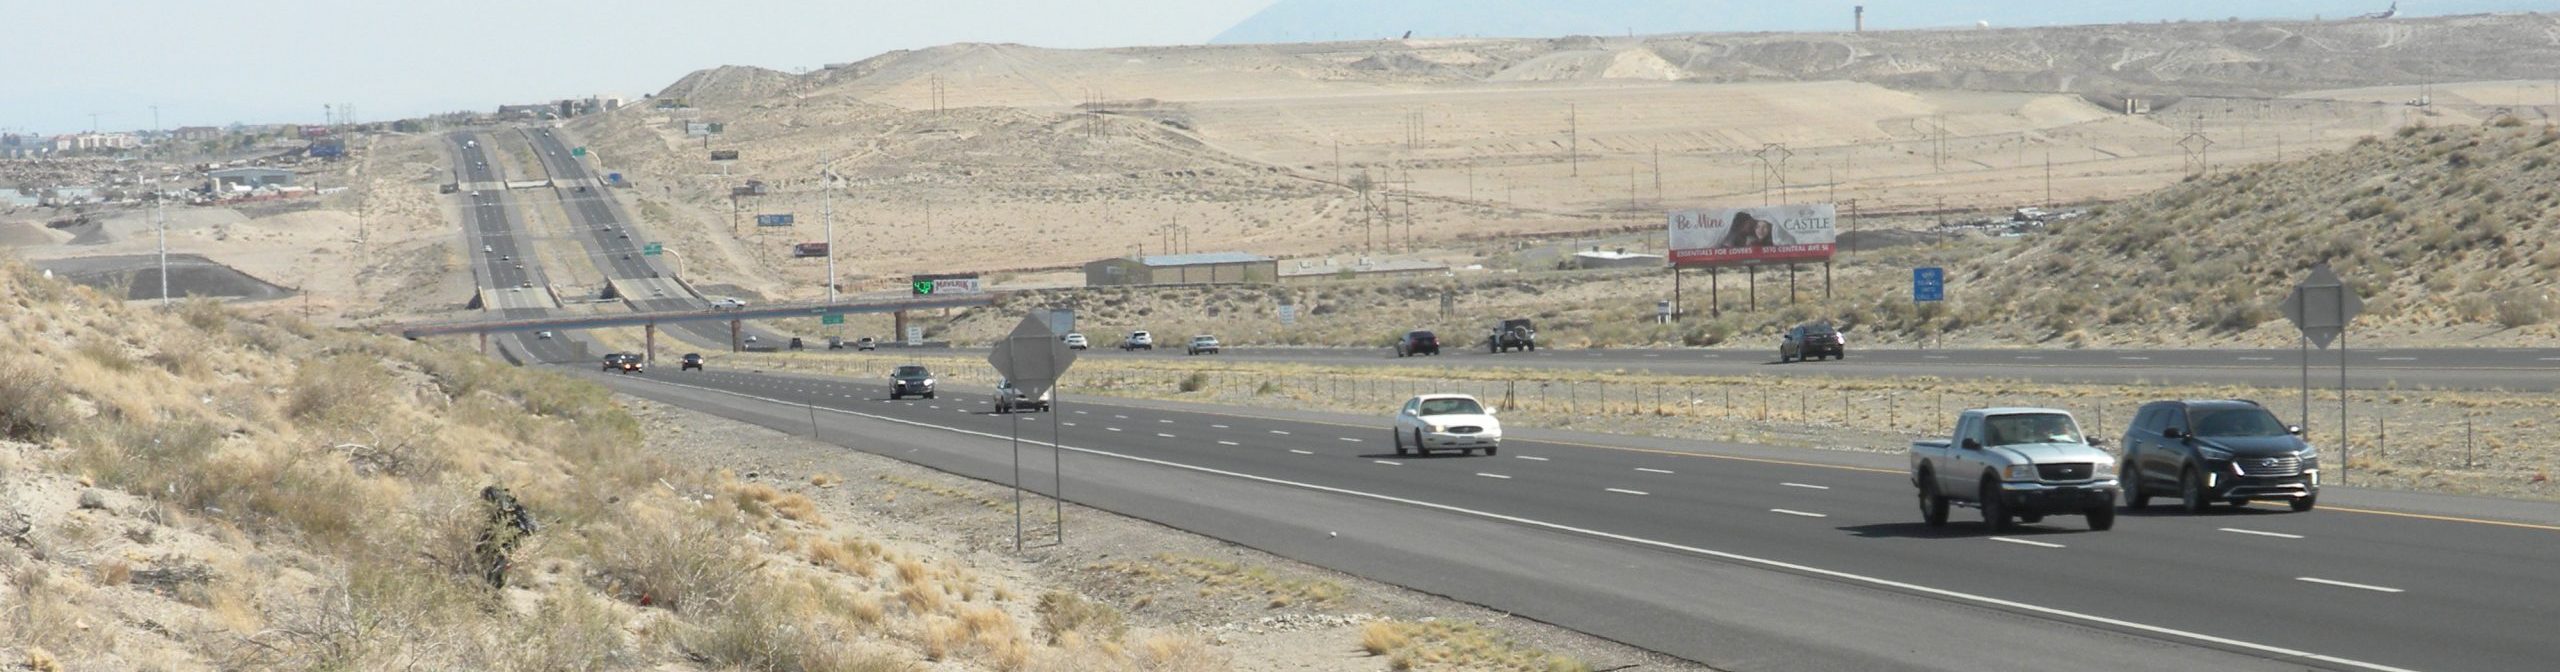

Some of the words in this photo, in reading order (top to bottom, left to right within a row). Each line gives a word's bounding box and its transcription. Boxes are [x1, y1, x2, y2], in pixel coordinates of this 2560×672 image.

[1676, 214, 1690, 230] Be
[1693, 213, 1725, 228] Mine
[1784, 217, 1830, 230] CASTLE
[1677, 248, 1713, 257] ESSENTIALS
[1715, 248, 1727, 256] FOR
[1729, 247, 1753, 255] LOVERS
[1778, 244, 1806, 253] CENTRAL
